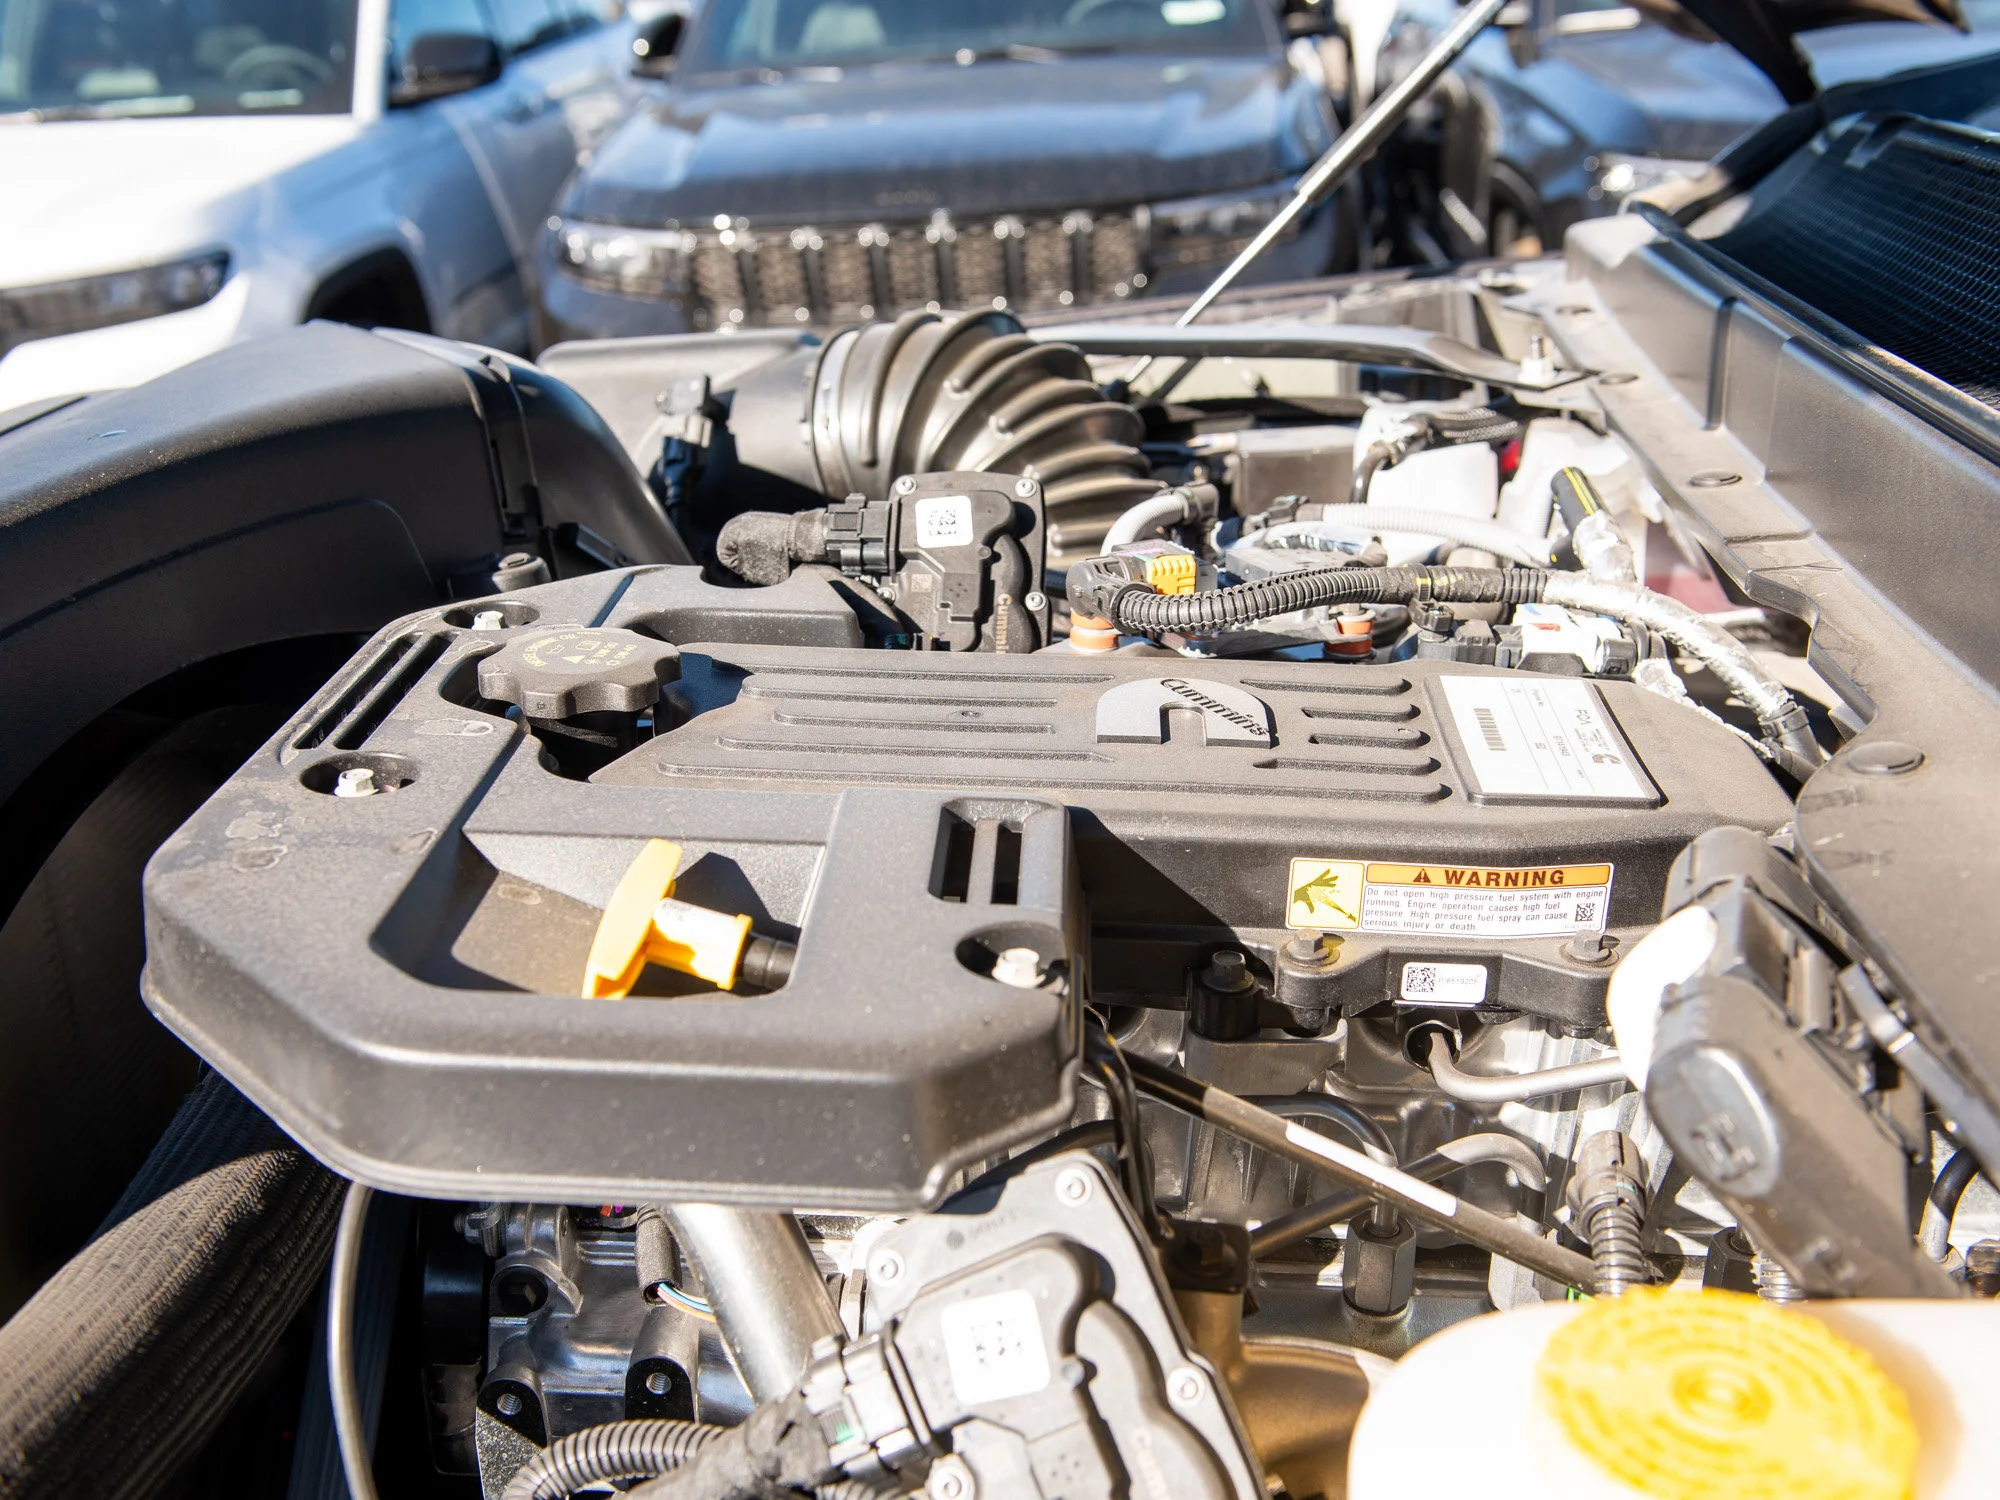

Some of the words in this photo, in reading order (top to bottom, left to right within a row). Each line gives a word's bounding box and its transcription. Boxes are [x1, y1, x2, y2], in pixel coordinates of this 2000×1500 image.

[1160, 678, 1269, 737] Cummins
[1444, 869, 1565, 887] WARNING
[1367, 887, 1379, 896] Do
[1383, 888, 1398, 897] not
[1403, 890, 1425, 900] open
[1430, 890, 1450, 901] high
[1454, 892, 1494, 902] pressure
[1499, 893, 1516, 902] fuel
[1519, 892, 1550, 902] system
[1554, 891, 1572, 899] with
[1576, 890, 1603, 899] engine
[1407, 899, 1437, 910] Engine
[1441, 902, 1484, 911] operation
[1488, 904, 1518, 912] causes
[1522, 903, 1541, 912] high
[1545, 902, 1560, 910] fuel
[1410, 911, 1430, 919] High
[1434, 911, 1473, 921] pressure
[1477, 914, 1494, 922] fuel
[1498, 914, 1522, 923] spray
[1544, 912, 1568, 920] cause
[1364, 919, 1398, 927] serious
[1403, 920, 1430, 930] injury
[1434, 922, 1445, 930] or
